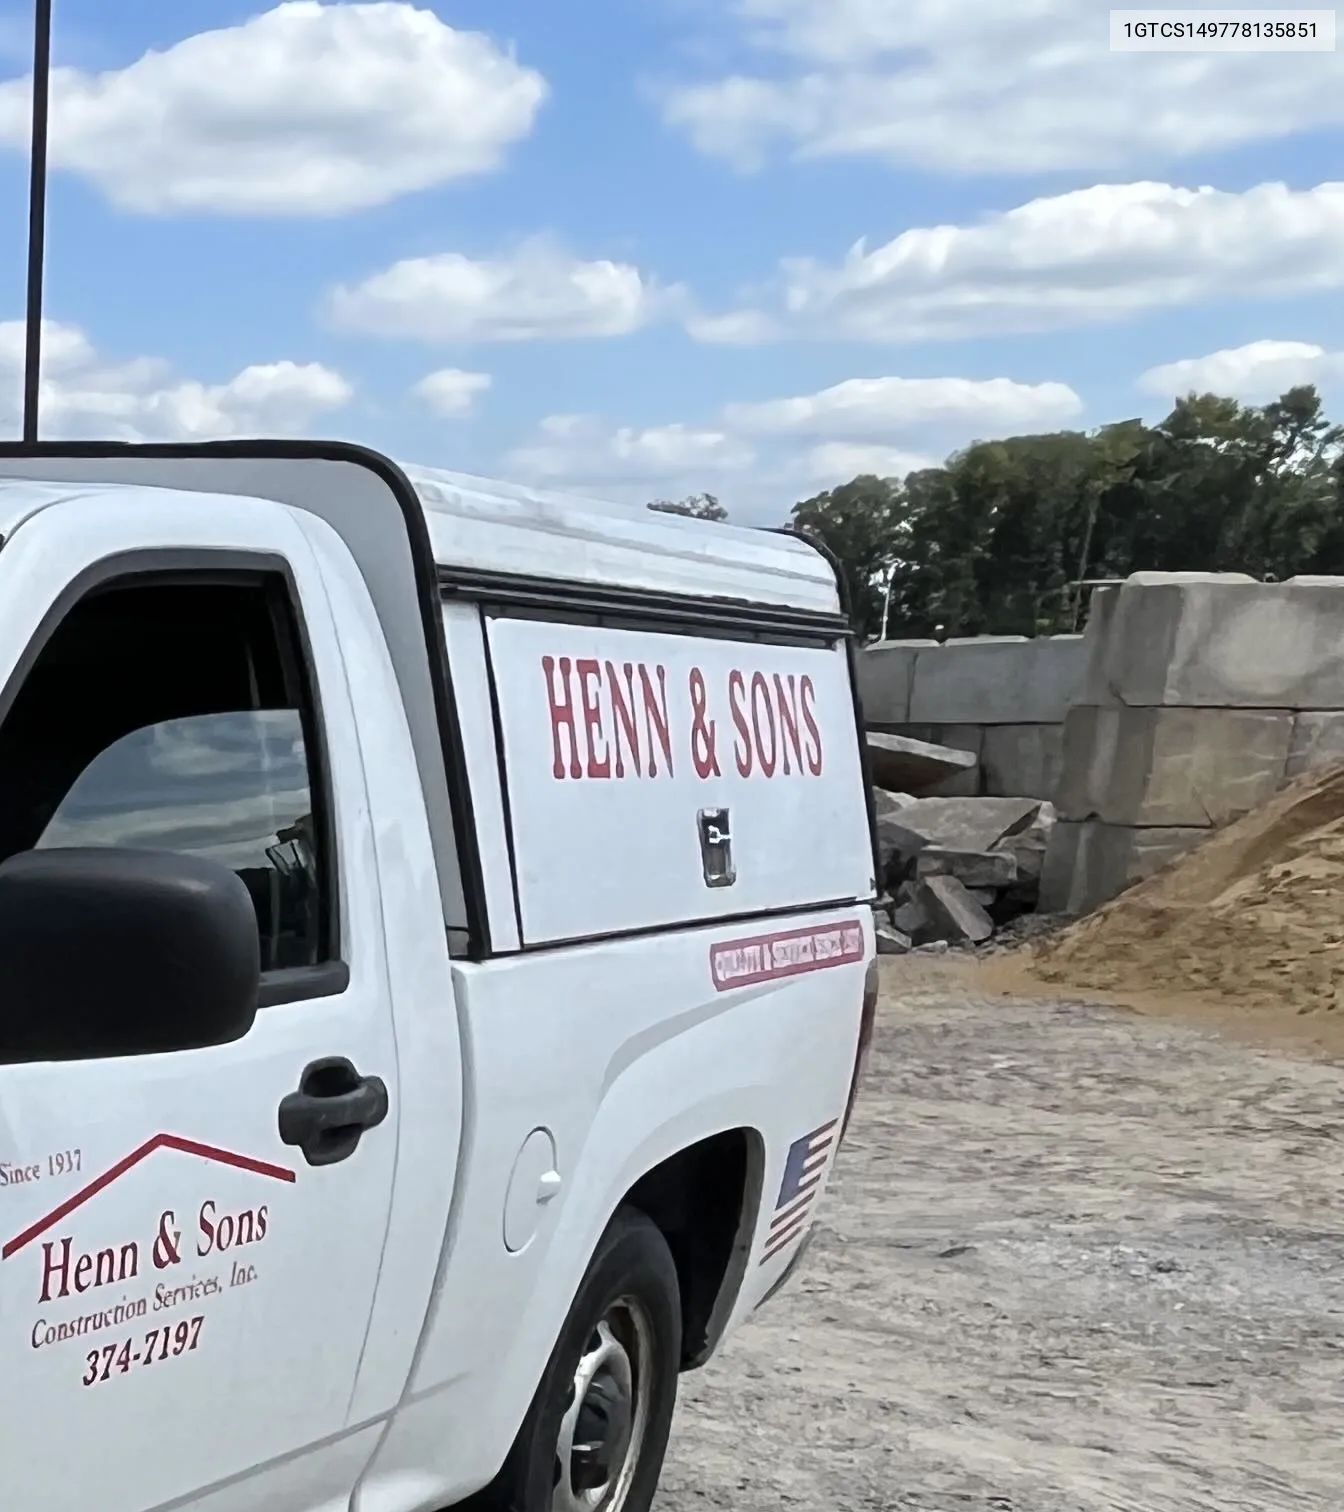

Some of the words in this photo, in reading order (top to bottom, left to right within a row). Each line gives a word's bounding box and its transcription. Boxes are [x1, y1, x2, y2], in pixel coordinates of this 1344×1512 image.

[541, 655, 674, 780] HENN
[689, 667, 722, 779] &
[729, 669, 822, 778] SONS
[48, 1149, 81, 1176] 1937
[38, 1236, 138, 1304] Henn
[152, 1210, 181, 1269] &
[197, 1200, 268, 1257] Sons
[31, 1296, 147, 1348] Construction
[153, 1274, 223, 1311] Services,
[229, 1261, 258, 1288] Inc.
[82, 1316, 205, 1387] 374-7197
